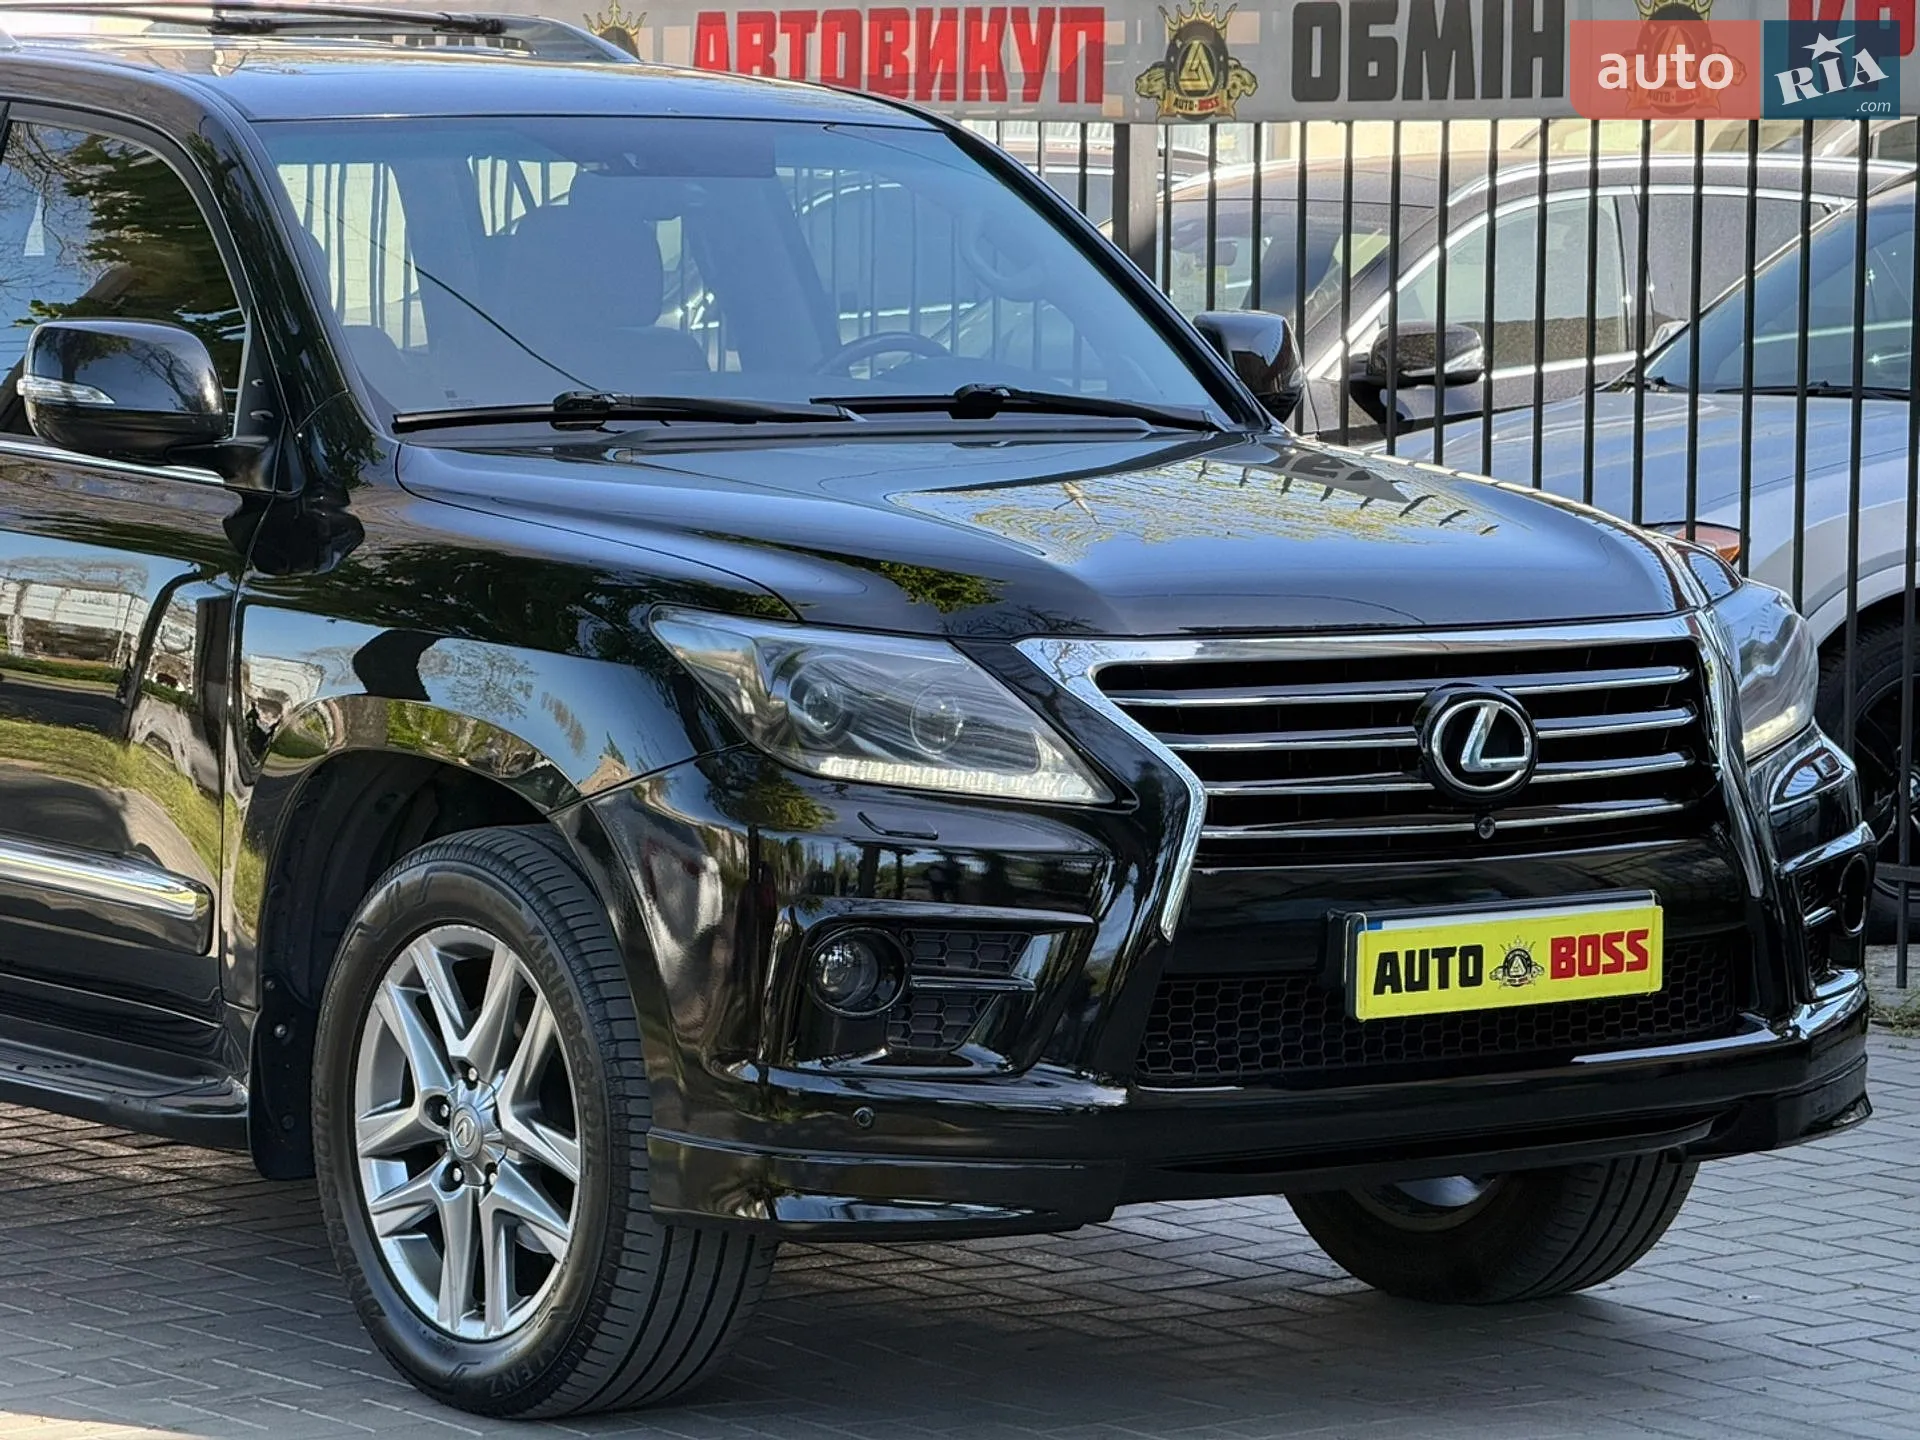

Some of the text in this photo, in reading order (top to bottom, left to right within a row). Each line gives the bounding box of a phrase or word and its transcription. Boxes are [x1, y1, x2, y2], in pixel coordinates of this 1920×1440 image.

[693, 7, 1105, 104] АВТОВИКУП
[1291, 0, 1564, 102] ОБМІН
[1373, 928, 1650, 996] AUTO BOSS
